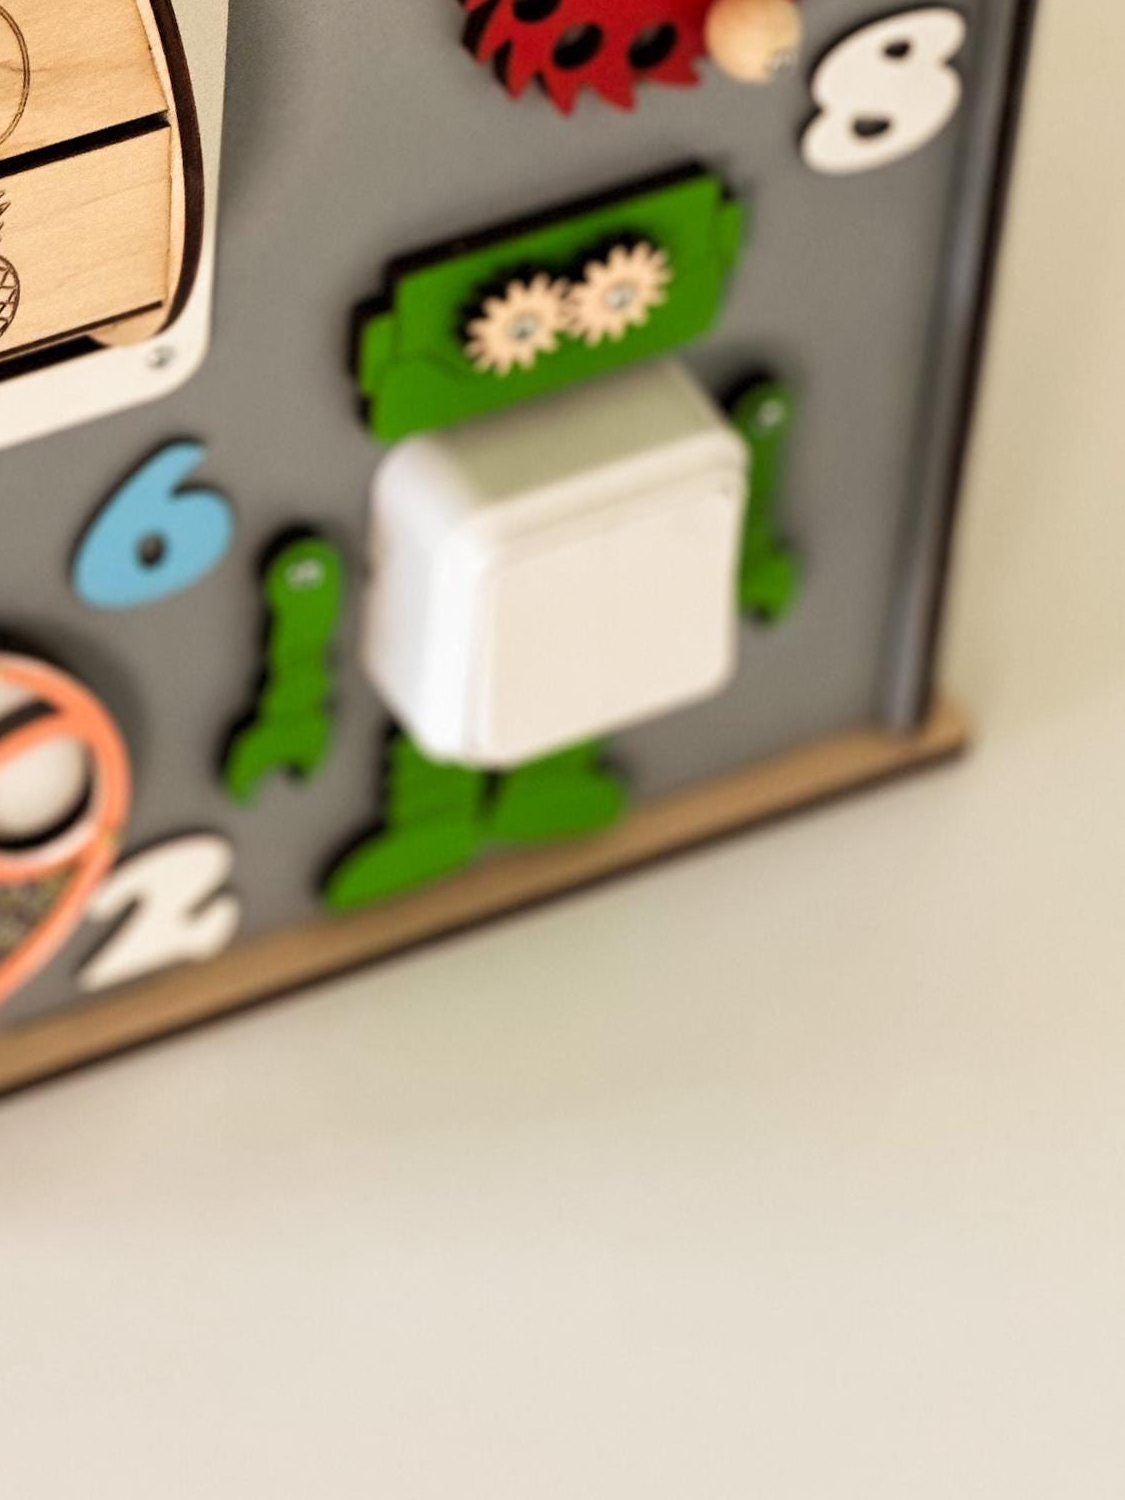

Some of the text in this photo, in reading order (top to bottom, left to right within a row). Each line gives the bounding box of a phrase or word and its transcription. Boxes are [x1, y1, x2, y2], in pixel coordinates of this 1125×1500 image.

[798, 5, 967, 176] 8
[72, 441, 235, 609] 6
[81, 832, 241, 991] 2
